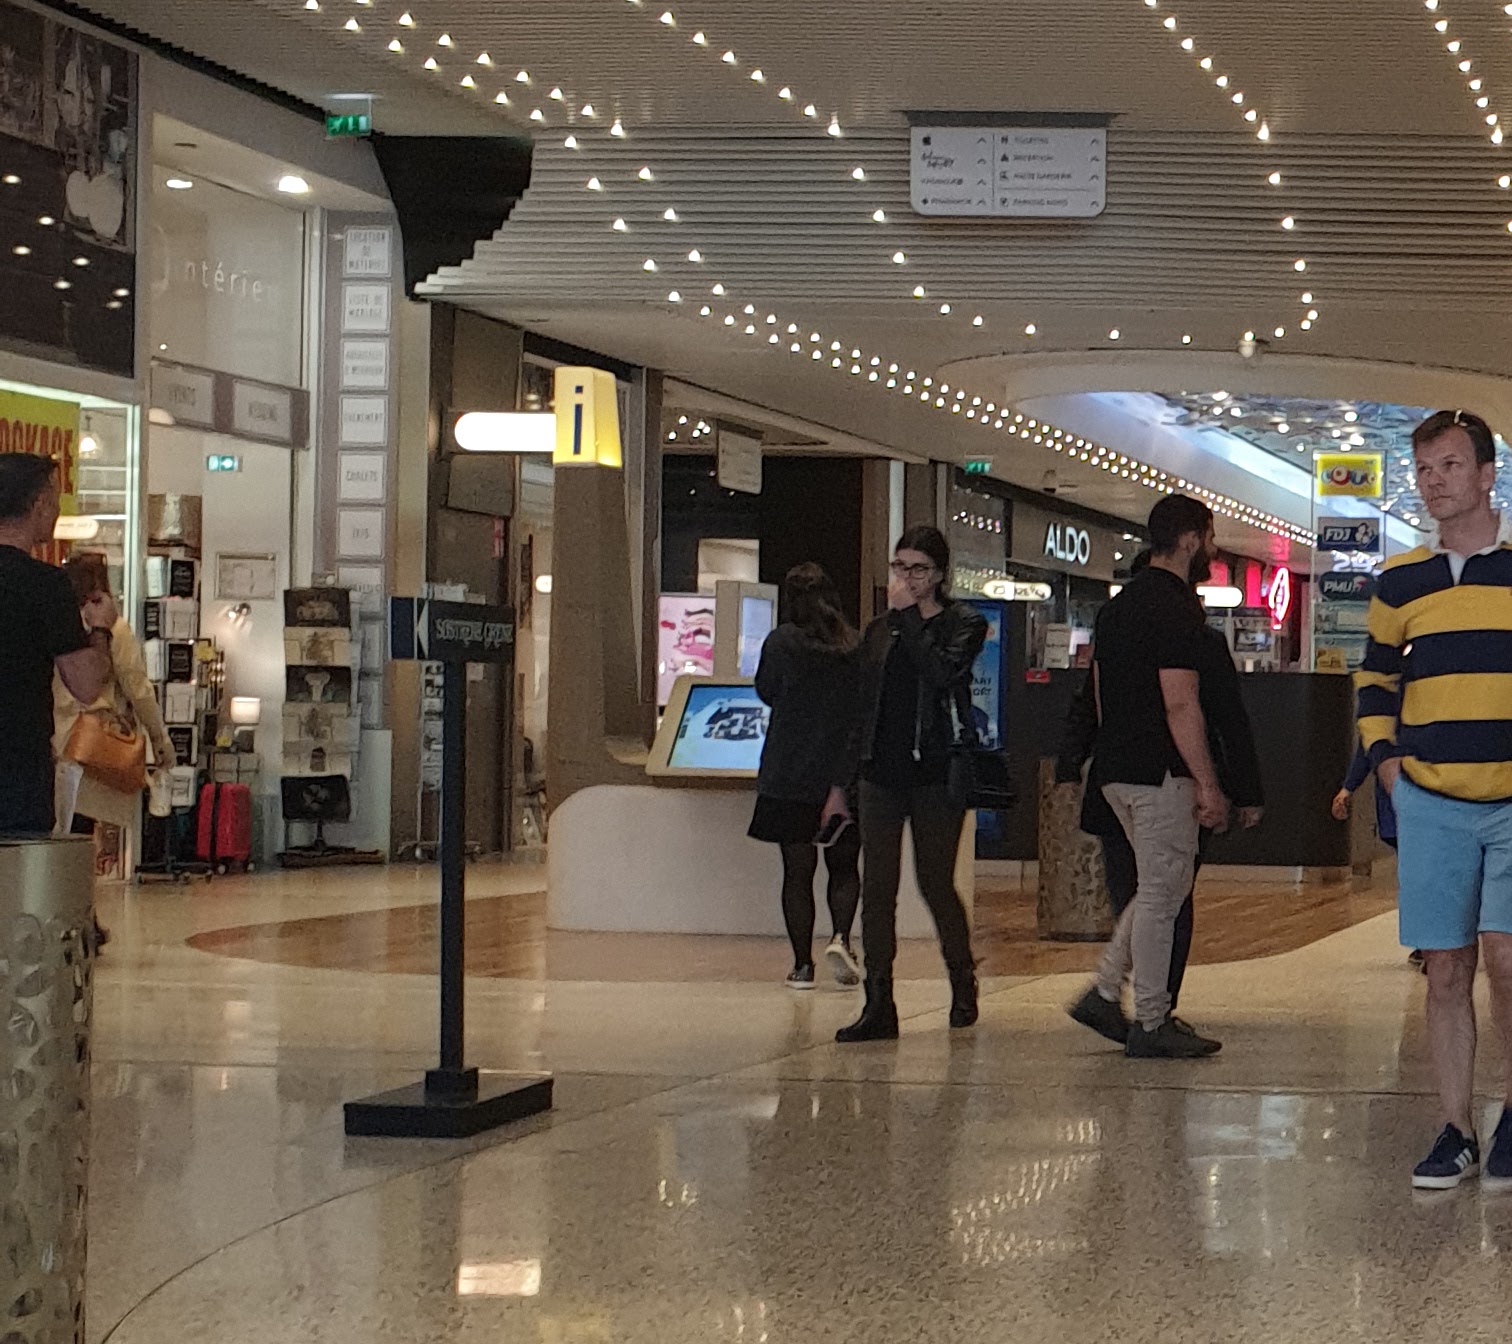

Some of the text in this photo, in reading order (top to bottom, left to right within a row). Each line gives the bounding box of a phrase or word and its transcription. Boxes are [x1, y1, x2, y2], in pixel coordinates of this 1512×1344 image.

[1324, 528, 1351, 542] FDJ
[1044, 523, 1090, 566] ALDO
[1324, 580, 1353, 593] PMU
